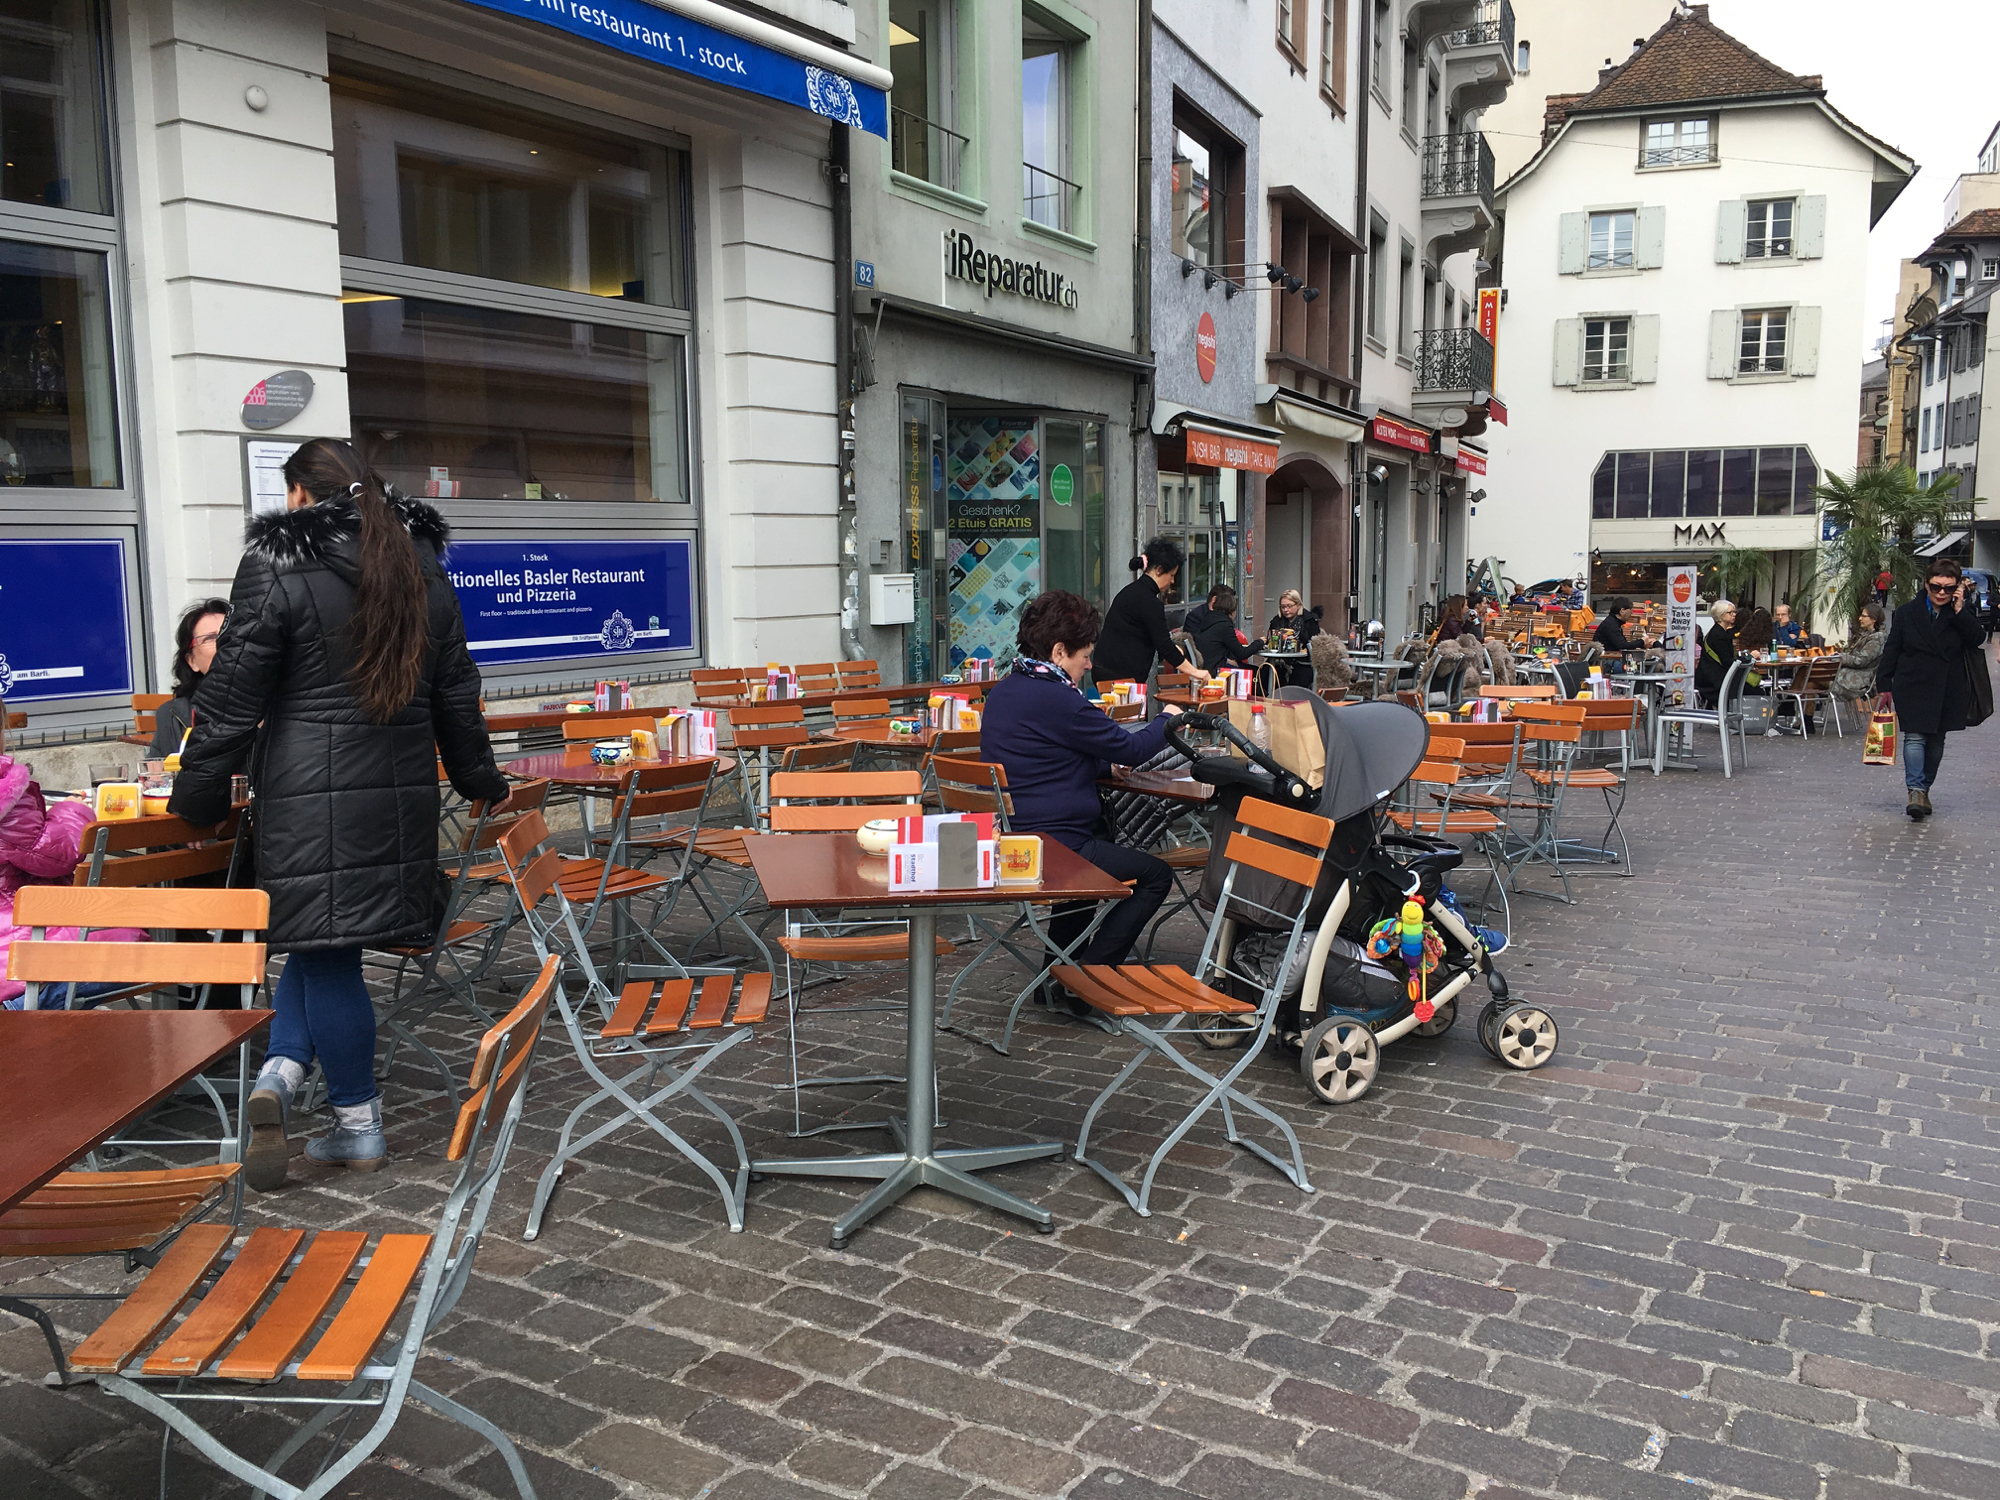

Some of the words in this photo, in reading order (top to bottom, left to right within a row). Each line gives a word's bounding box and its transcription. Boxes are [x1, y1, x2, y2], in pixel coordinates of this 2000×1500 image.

[570, 2, 673, 52] restaurant
[677, 36, 694, 59] 1.
[699, 46, 747, 75] stock
[860, 265, 871, 283] 82
[911, 415, 920, 481] Reparatur
[1210, 444, 1220, 460] BAR
[1224, 445, 1248, 466] negishi
[1251, 451, 1263, 467] TAKE
[958, 504, 1021, 516] Geschenk?
[911, 485, 920, 560] EXPRESS
[948, 518, 956, 528] 2
[958, 518, 987, 528] Etuis
[989, 517, 1032, 528] GRATIS
[1675, 522, 1726, 540] MAX
[530, 553, 549, 562] Stock
[447, 570, 521, 588] itionelles
[524, 568, 569, 586] Basler
[572, 568, 645, 584] Restaurant
[497, 588, 523, 603] und
[526, 587, 577, 602] Pizzeria
[507, 608, 531, 616] traditional
[1671, 610, 1691, 618] Take
[1671, 617, 1691, 626] Away
